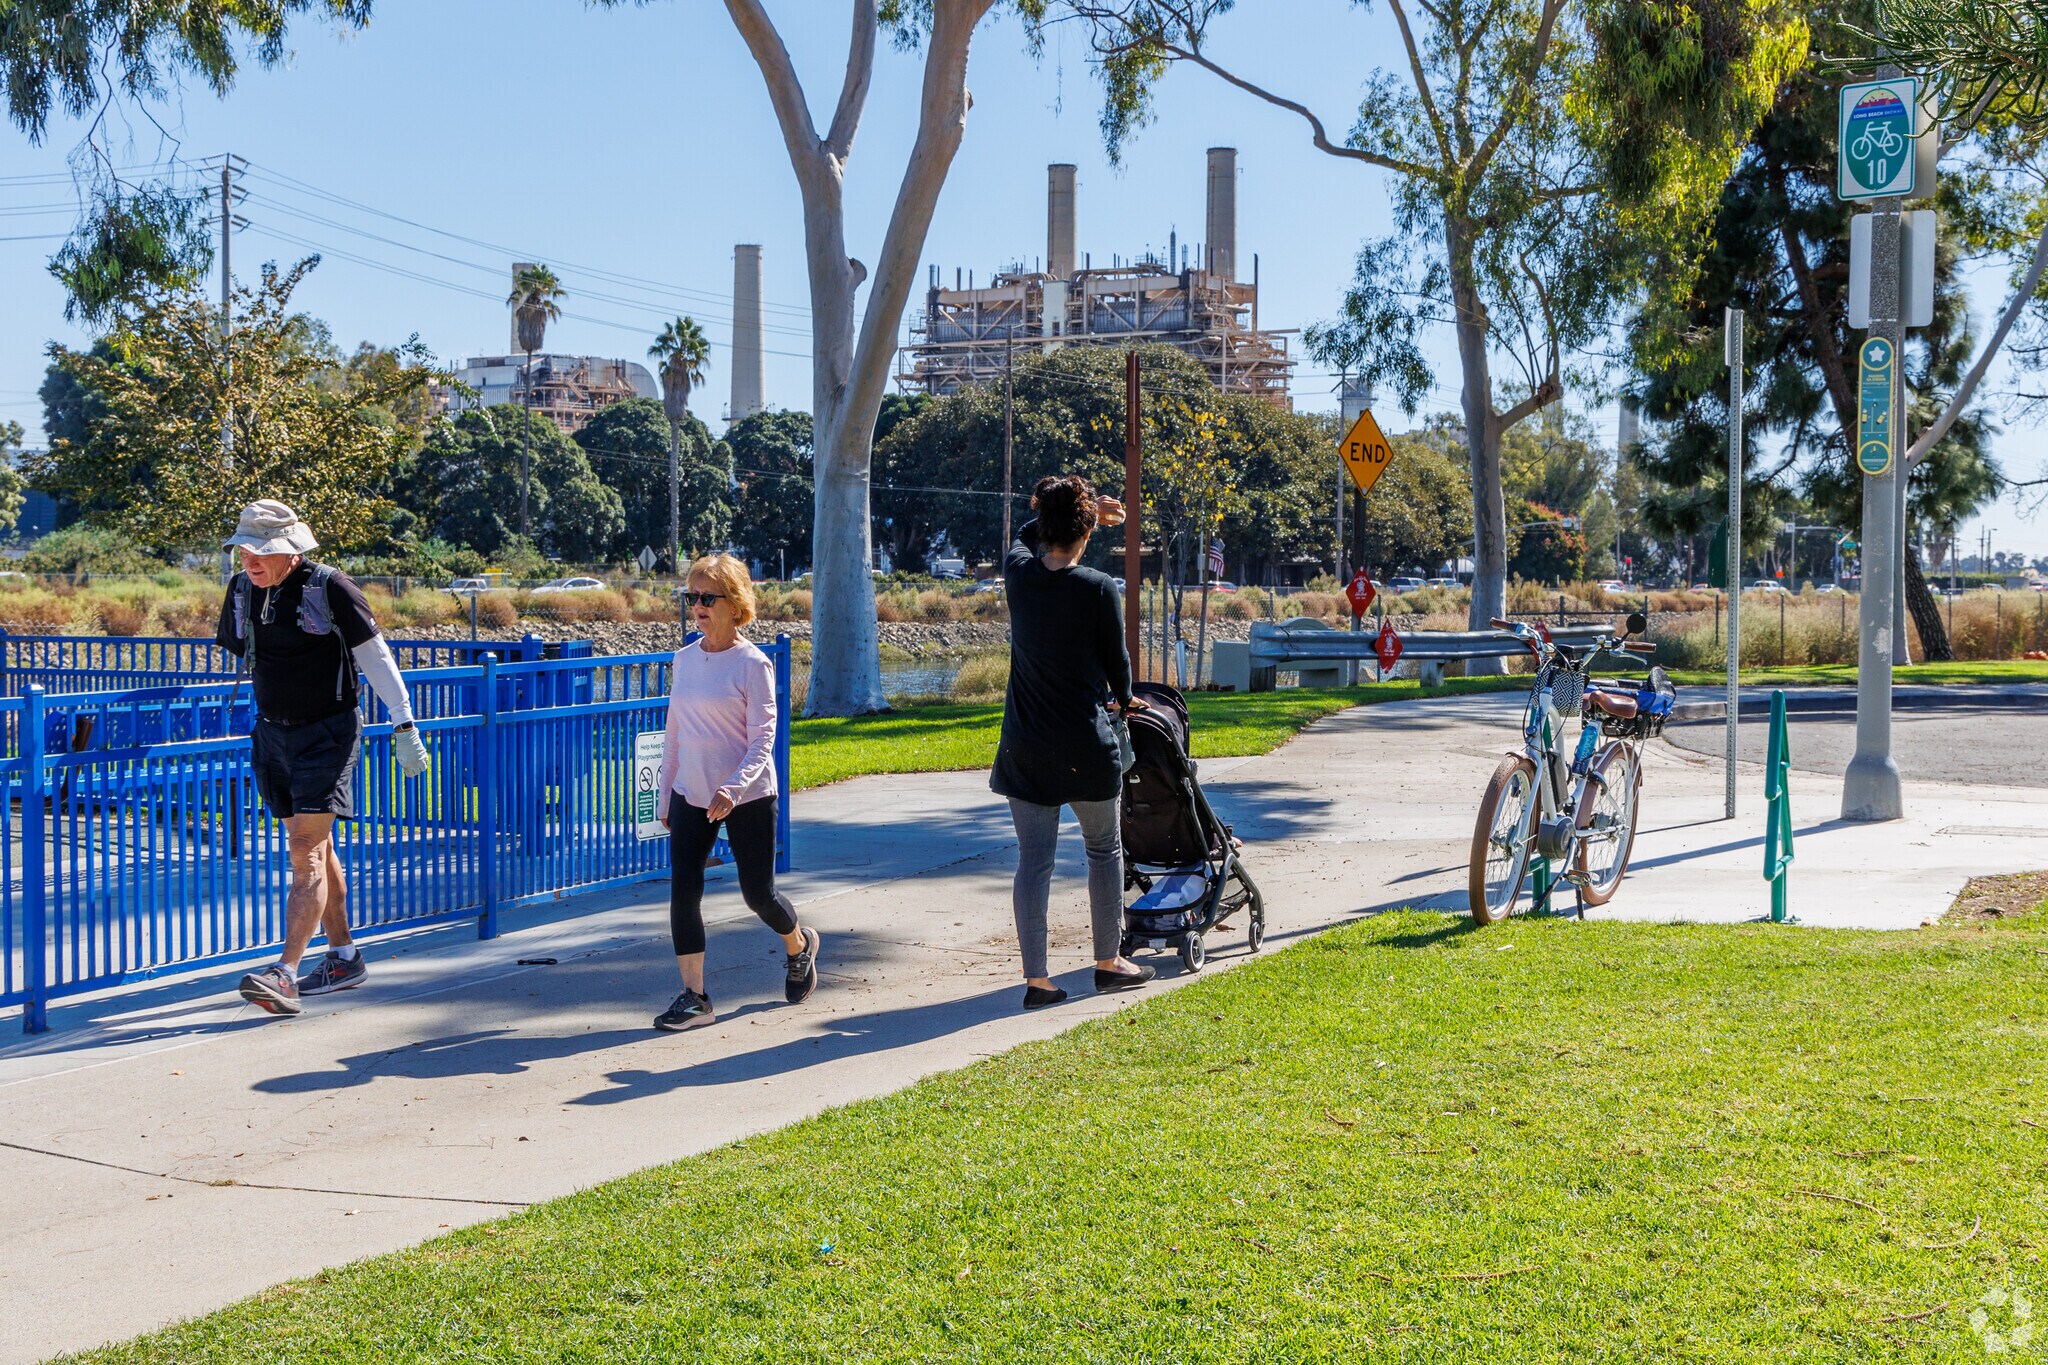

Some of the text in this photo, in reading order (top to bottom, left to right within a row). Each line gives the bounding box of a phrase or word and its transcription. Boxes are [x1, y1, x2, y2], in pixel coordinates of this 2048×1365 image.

[1867, 158, 1887, 185] 10
[1350, 442, 1385, 463] END
[651, 742, 661, 750] Keep
